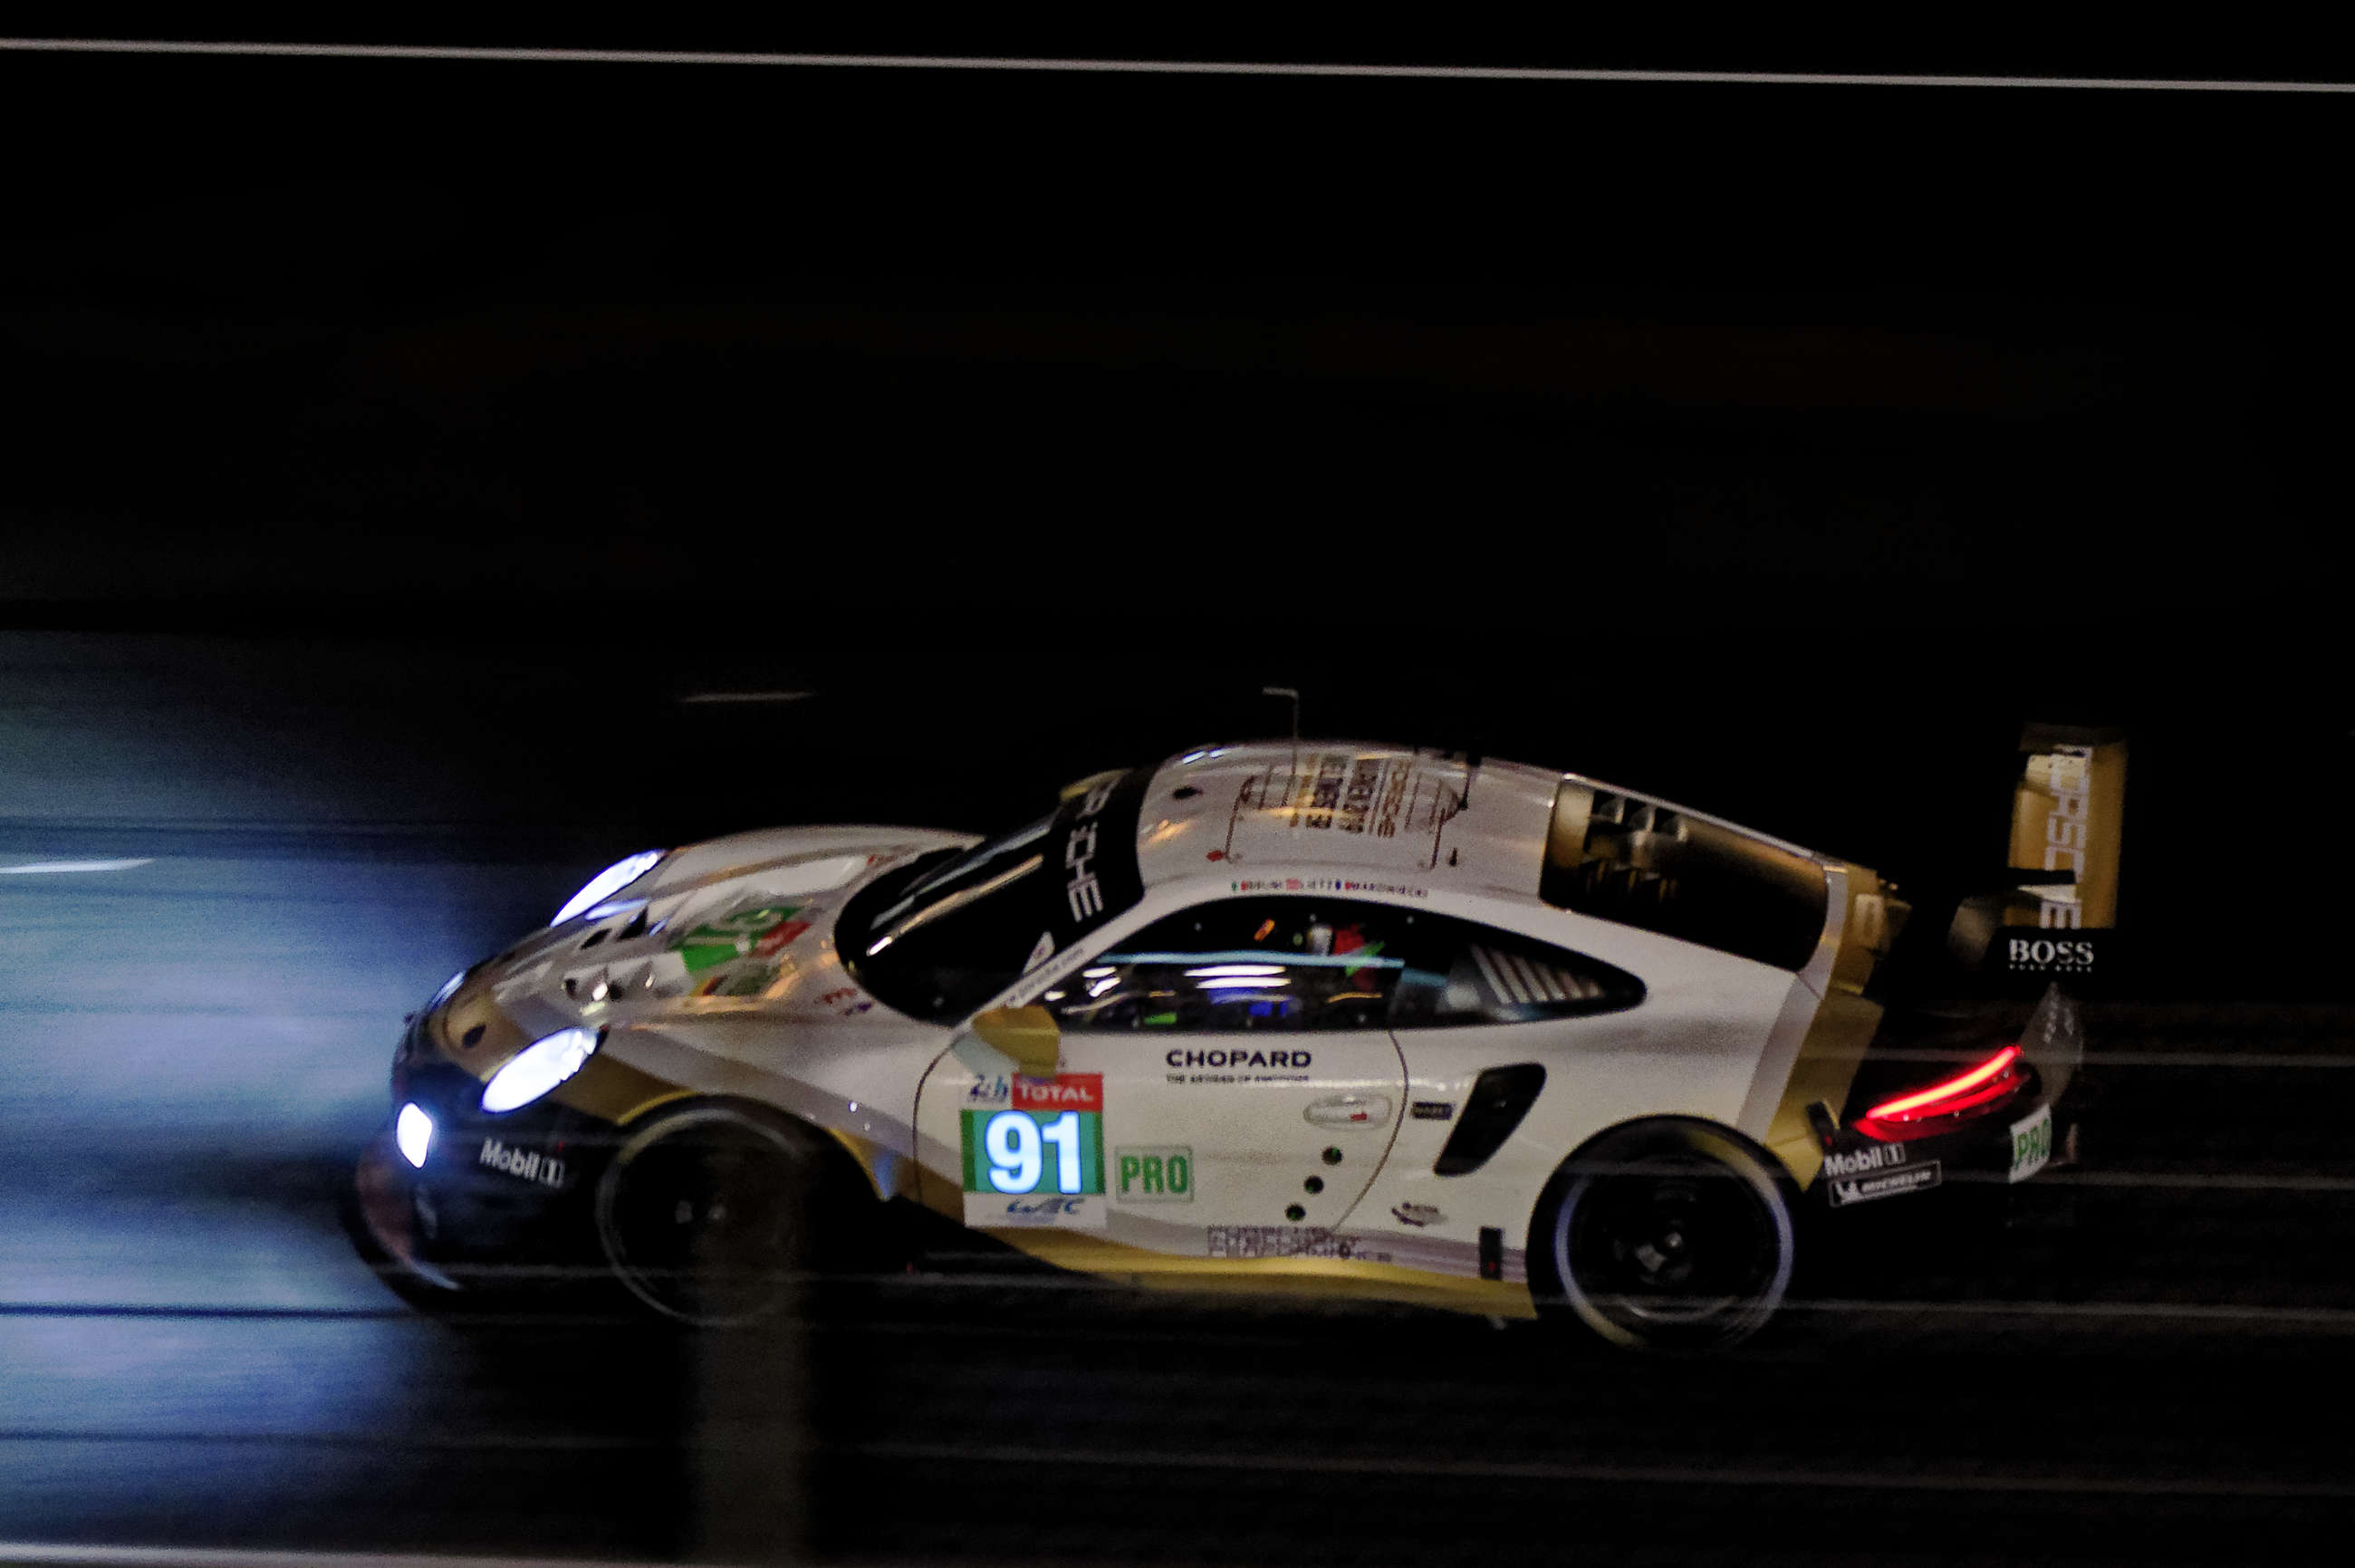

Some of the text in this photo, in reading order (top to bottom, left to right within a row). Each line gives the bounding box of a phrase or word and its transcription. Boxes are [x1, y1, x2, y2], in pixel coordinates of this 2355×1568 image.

[2008, 938, 2094, 965] BOSS
[1166, 1049, 1312, 1068] CHOPARD
[1020, 1083, 1094, 1101] TOTAL
[479, 1136, 540, 1181] Mobil
[985, 1109, 1082, 1195] 91
[1824, 1146, 1884, 1177] Mobil
[1120, 1154, 1188, 1194] PRO
